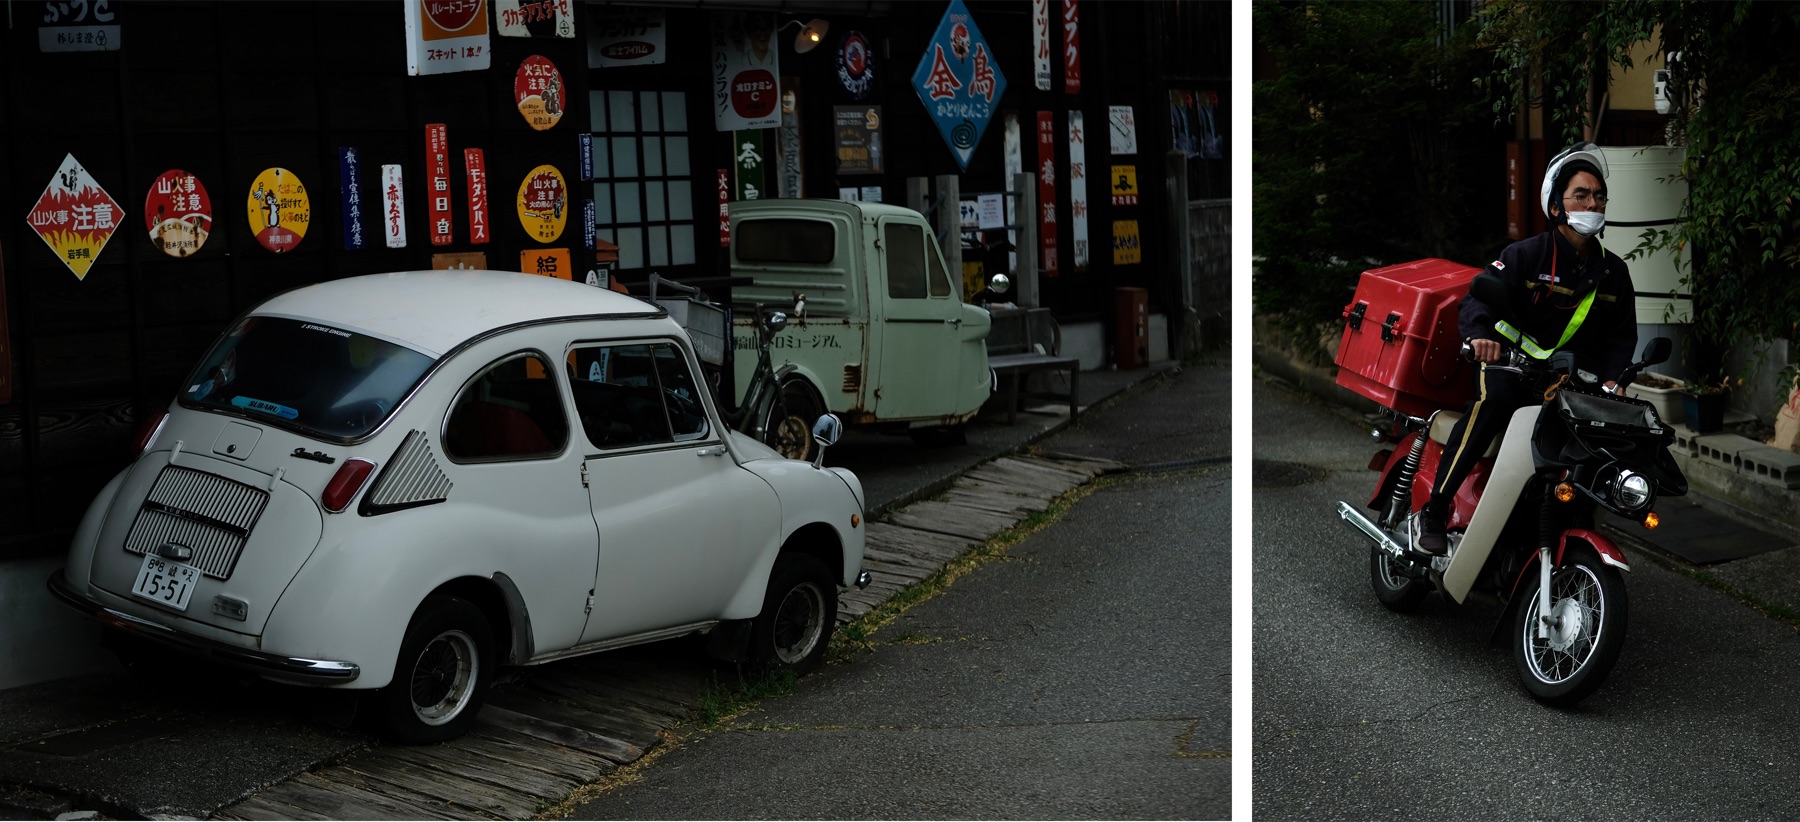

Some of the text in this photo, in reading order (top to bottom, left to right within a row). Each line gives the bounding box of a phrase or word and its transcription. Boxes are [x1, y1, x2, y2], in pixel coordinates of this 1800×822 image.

[524, 63, 551, 77] 火気に
[923, 42, 997, 103] 金鳥
[528, 78, 547, 90] 注意
[735, 80, 773, 93] オロナミン
[750, 92, 760, 101] C
[158, 175, 196, 194] 山火事
[277, 184, 304, 194] たばこの
[533, 178, 558, 189] 山火事
[537, 190, 555, 200] 注意
[172, 193, 202, 212] 注意
[717, 173, 730, 233] 火の用心
[68, 248, 90, 259] 岩手県
[248, 400, 279, 413] SUBARU
